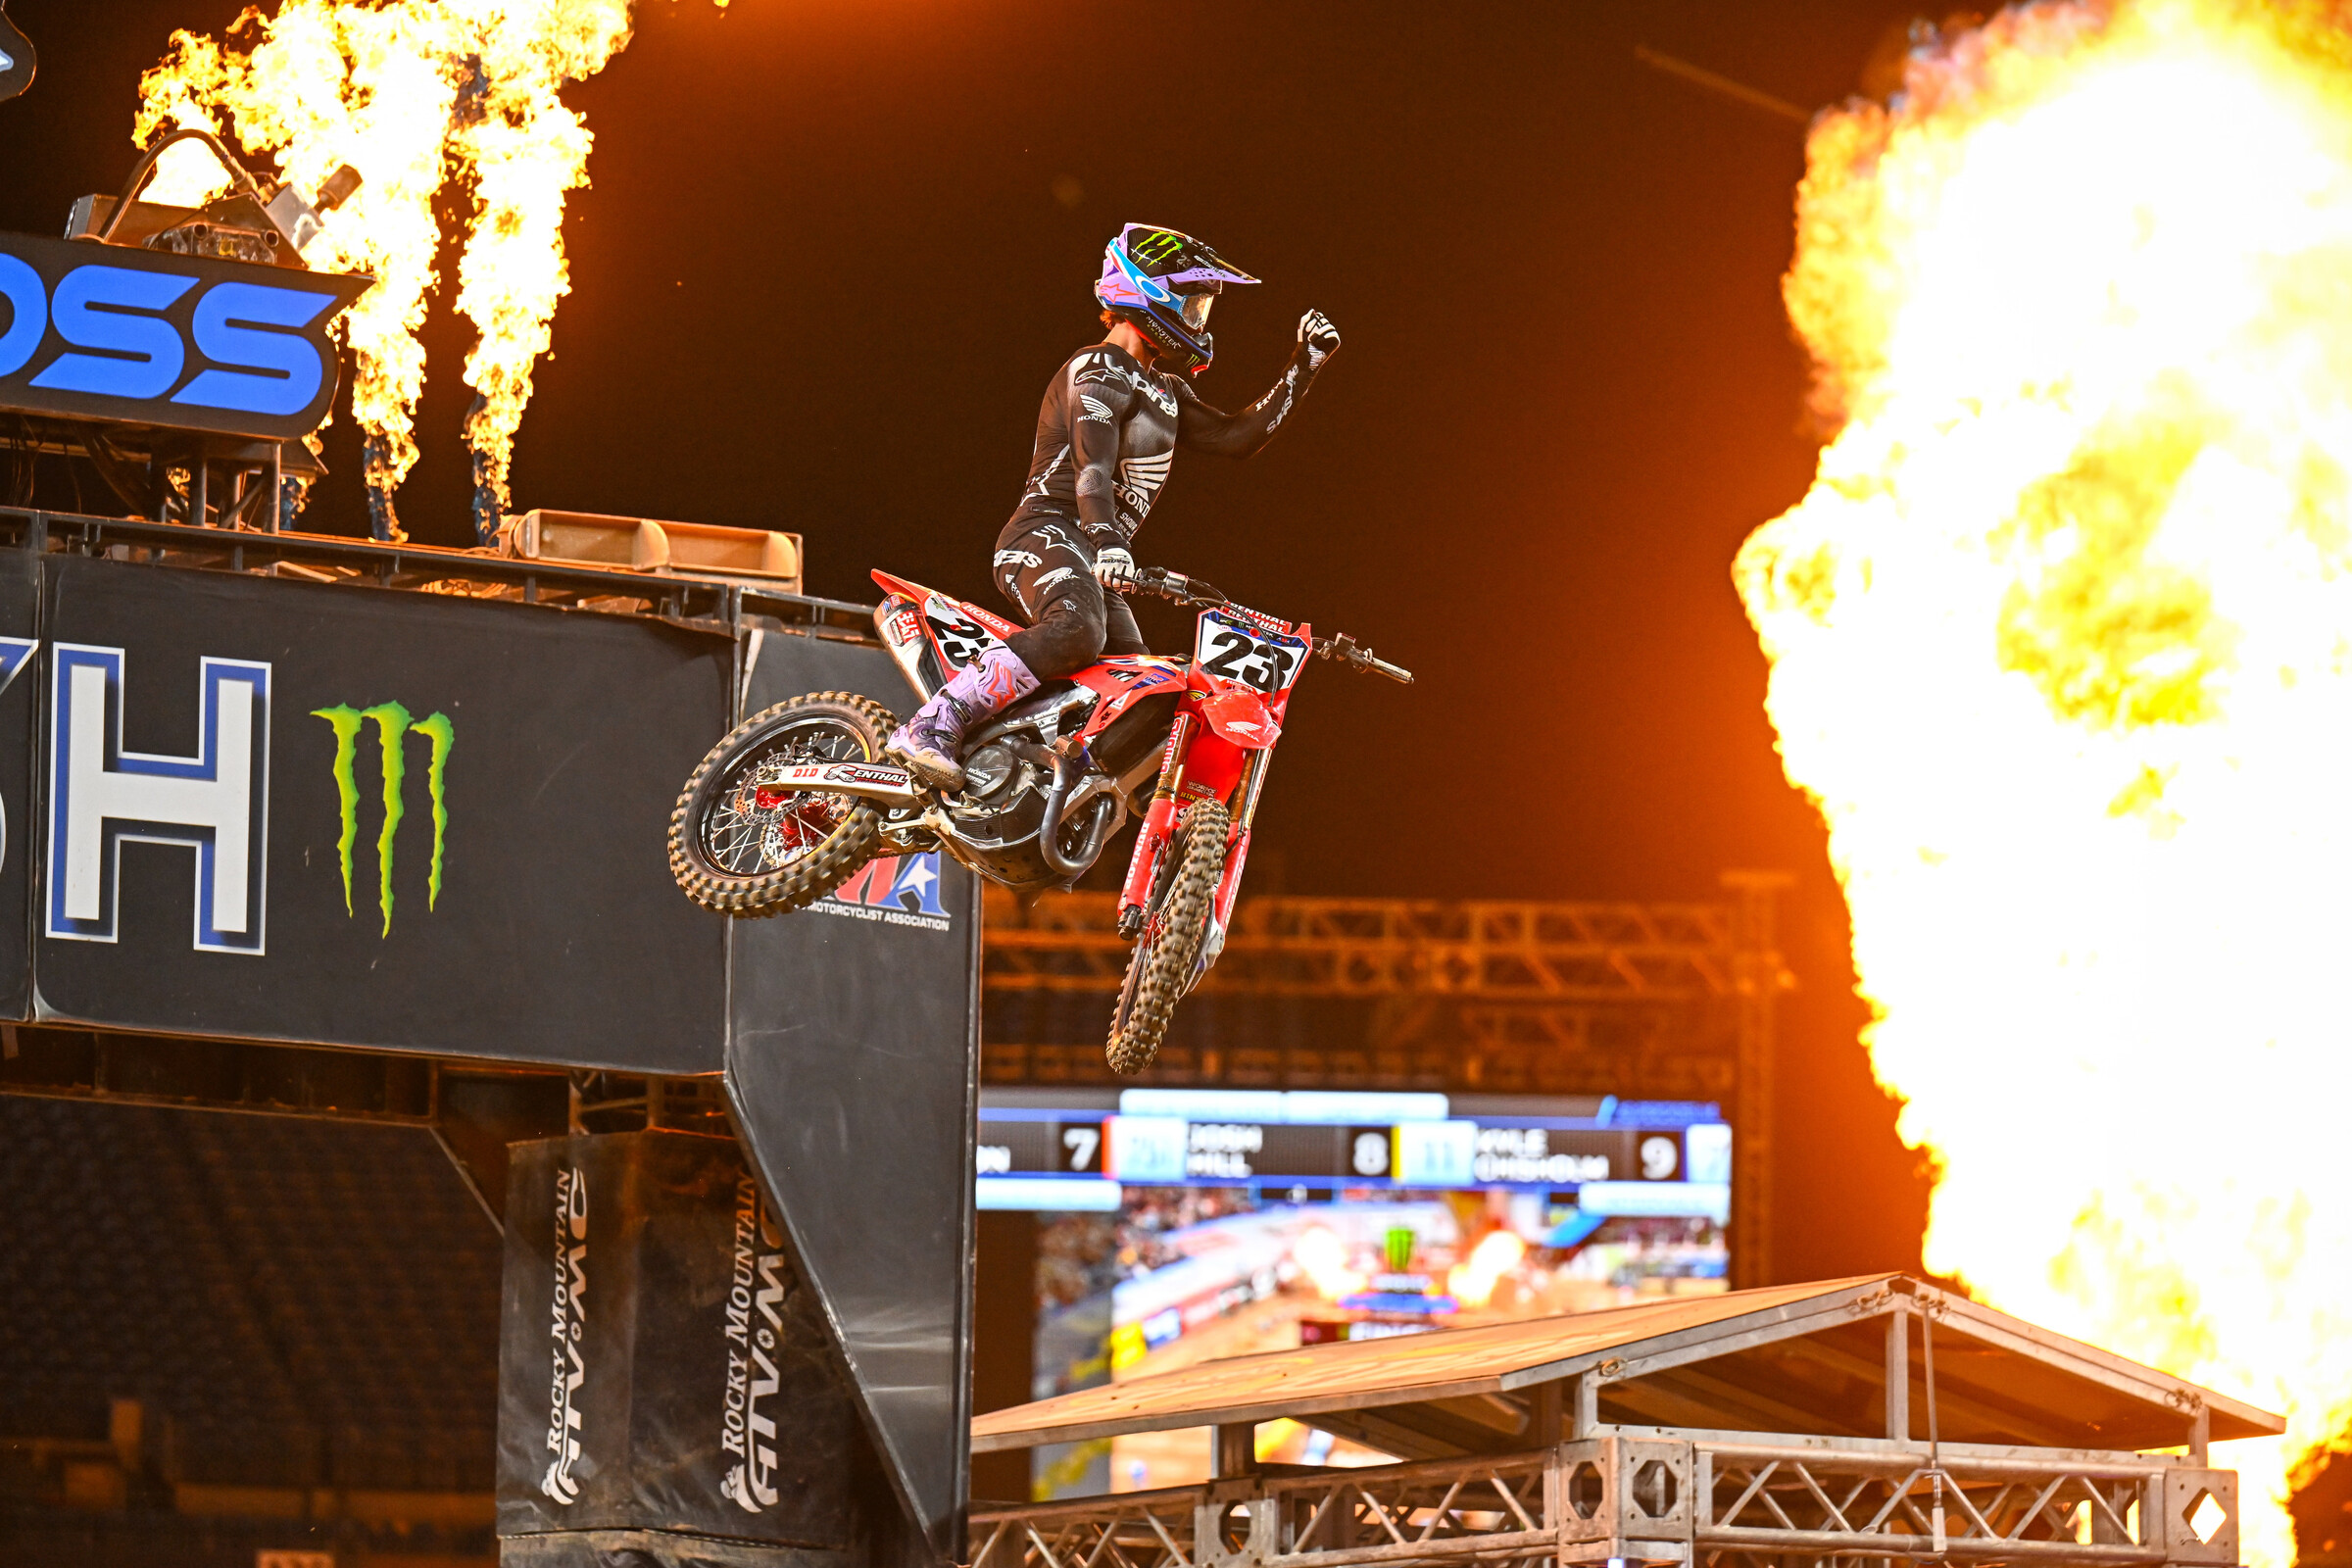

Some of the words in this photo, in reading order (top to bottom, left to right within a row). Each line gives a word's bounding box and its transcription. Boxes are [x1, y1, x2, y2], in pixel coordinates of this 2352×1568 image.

[1146, 316, 1182, 349] MONSTER
[1076, 415, 1113, 427] HONDA
[962, 604, 1010, 633] HONDA
[1200, 631, 1295, 694] 23
[967, 767, 992, 781] HONDA
[1124, 822, 1151, 891] DUNLOP
[884, 911, 950, 931] ASSOCIATION
[1063, 1128, 1100, 1171] 7
[1352, 1131, 1390, 1176] 8
[1640, 1136, 1677, 1181] 9
[551, 1168, 570, 1346] MOUNTAIN
[724, 1170, 756, 1349] MOUNTAIN
[722, 1348, 748, 1458] ROCKY
